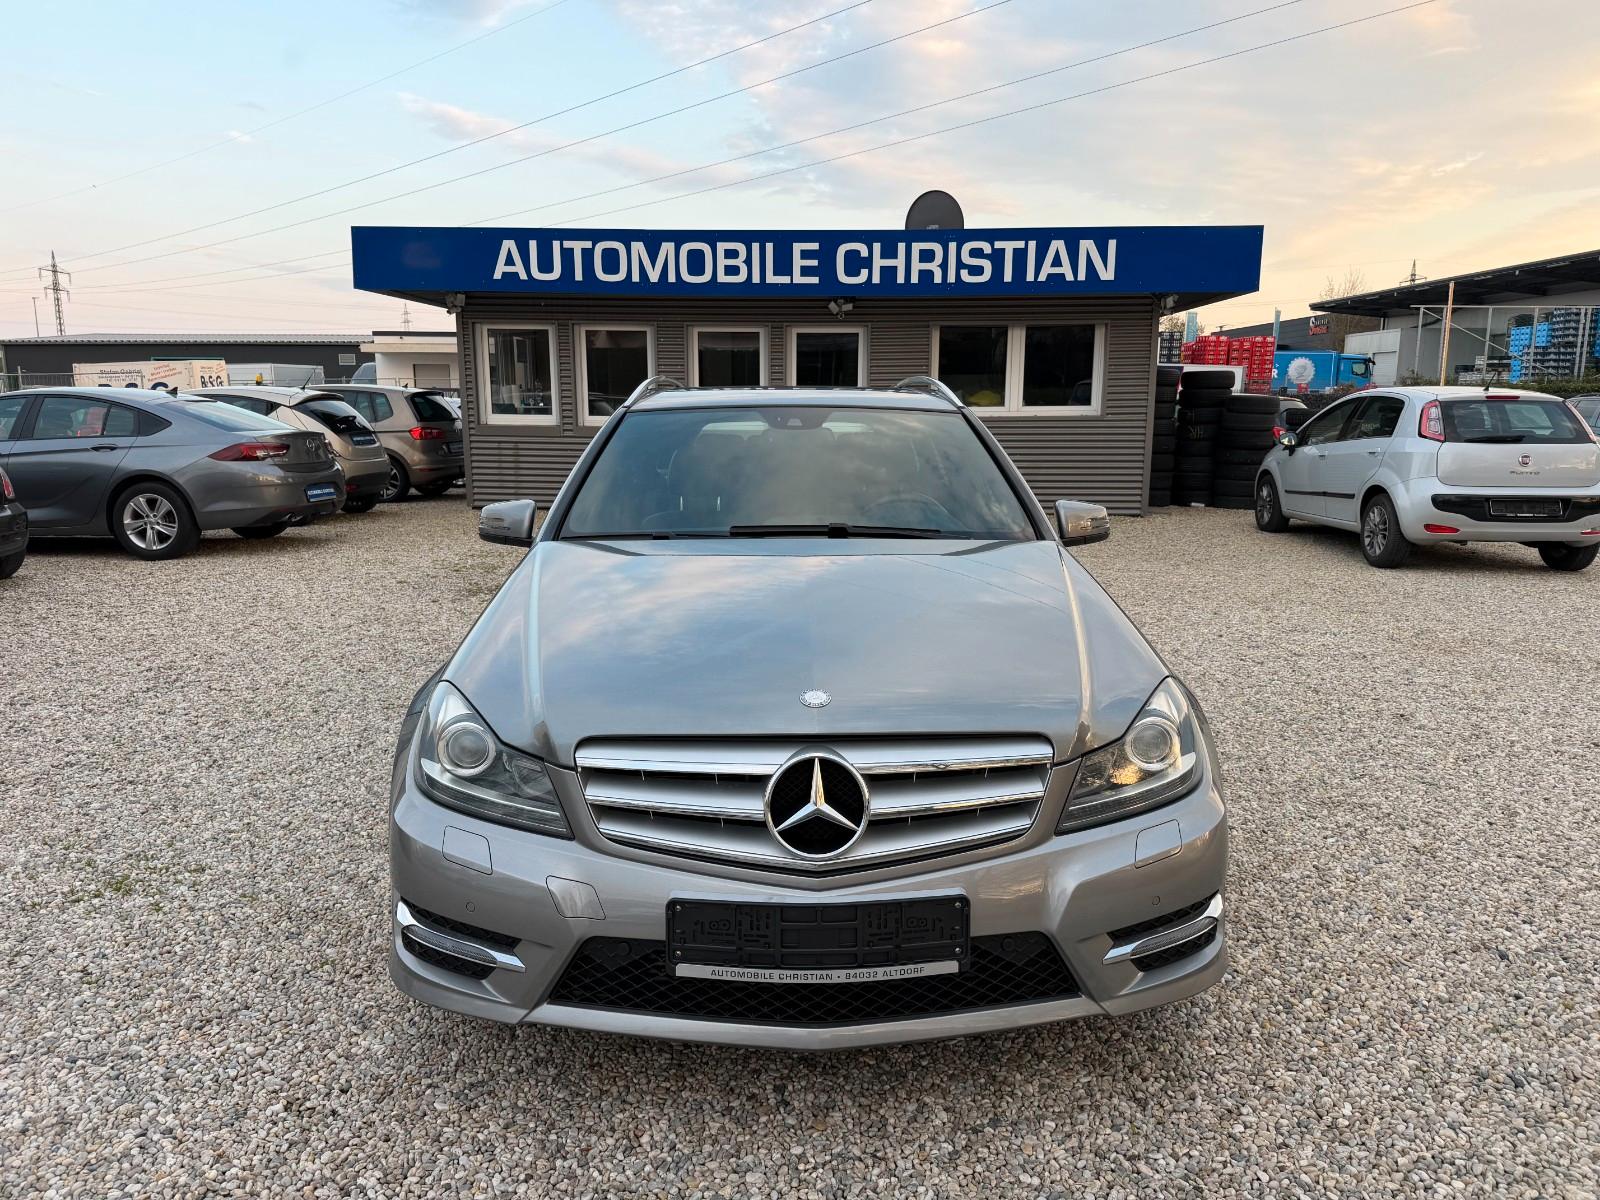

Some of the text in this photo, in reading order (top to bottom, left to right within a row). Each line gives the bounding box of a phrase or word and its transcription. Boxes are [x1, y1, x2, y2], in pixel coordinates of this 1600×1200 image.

[493, 239, 1117, 284] AUTOMOBILE CHRISTIAN
[710, 967, 925, 982] AUTOMOBILE CHRISTIAN 84032 ALTDORF
